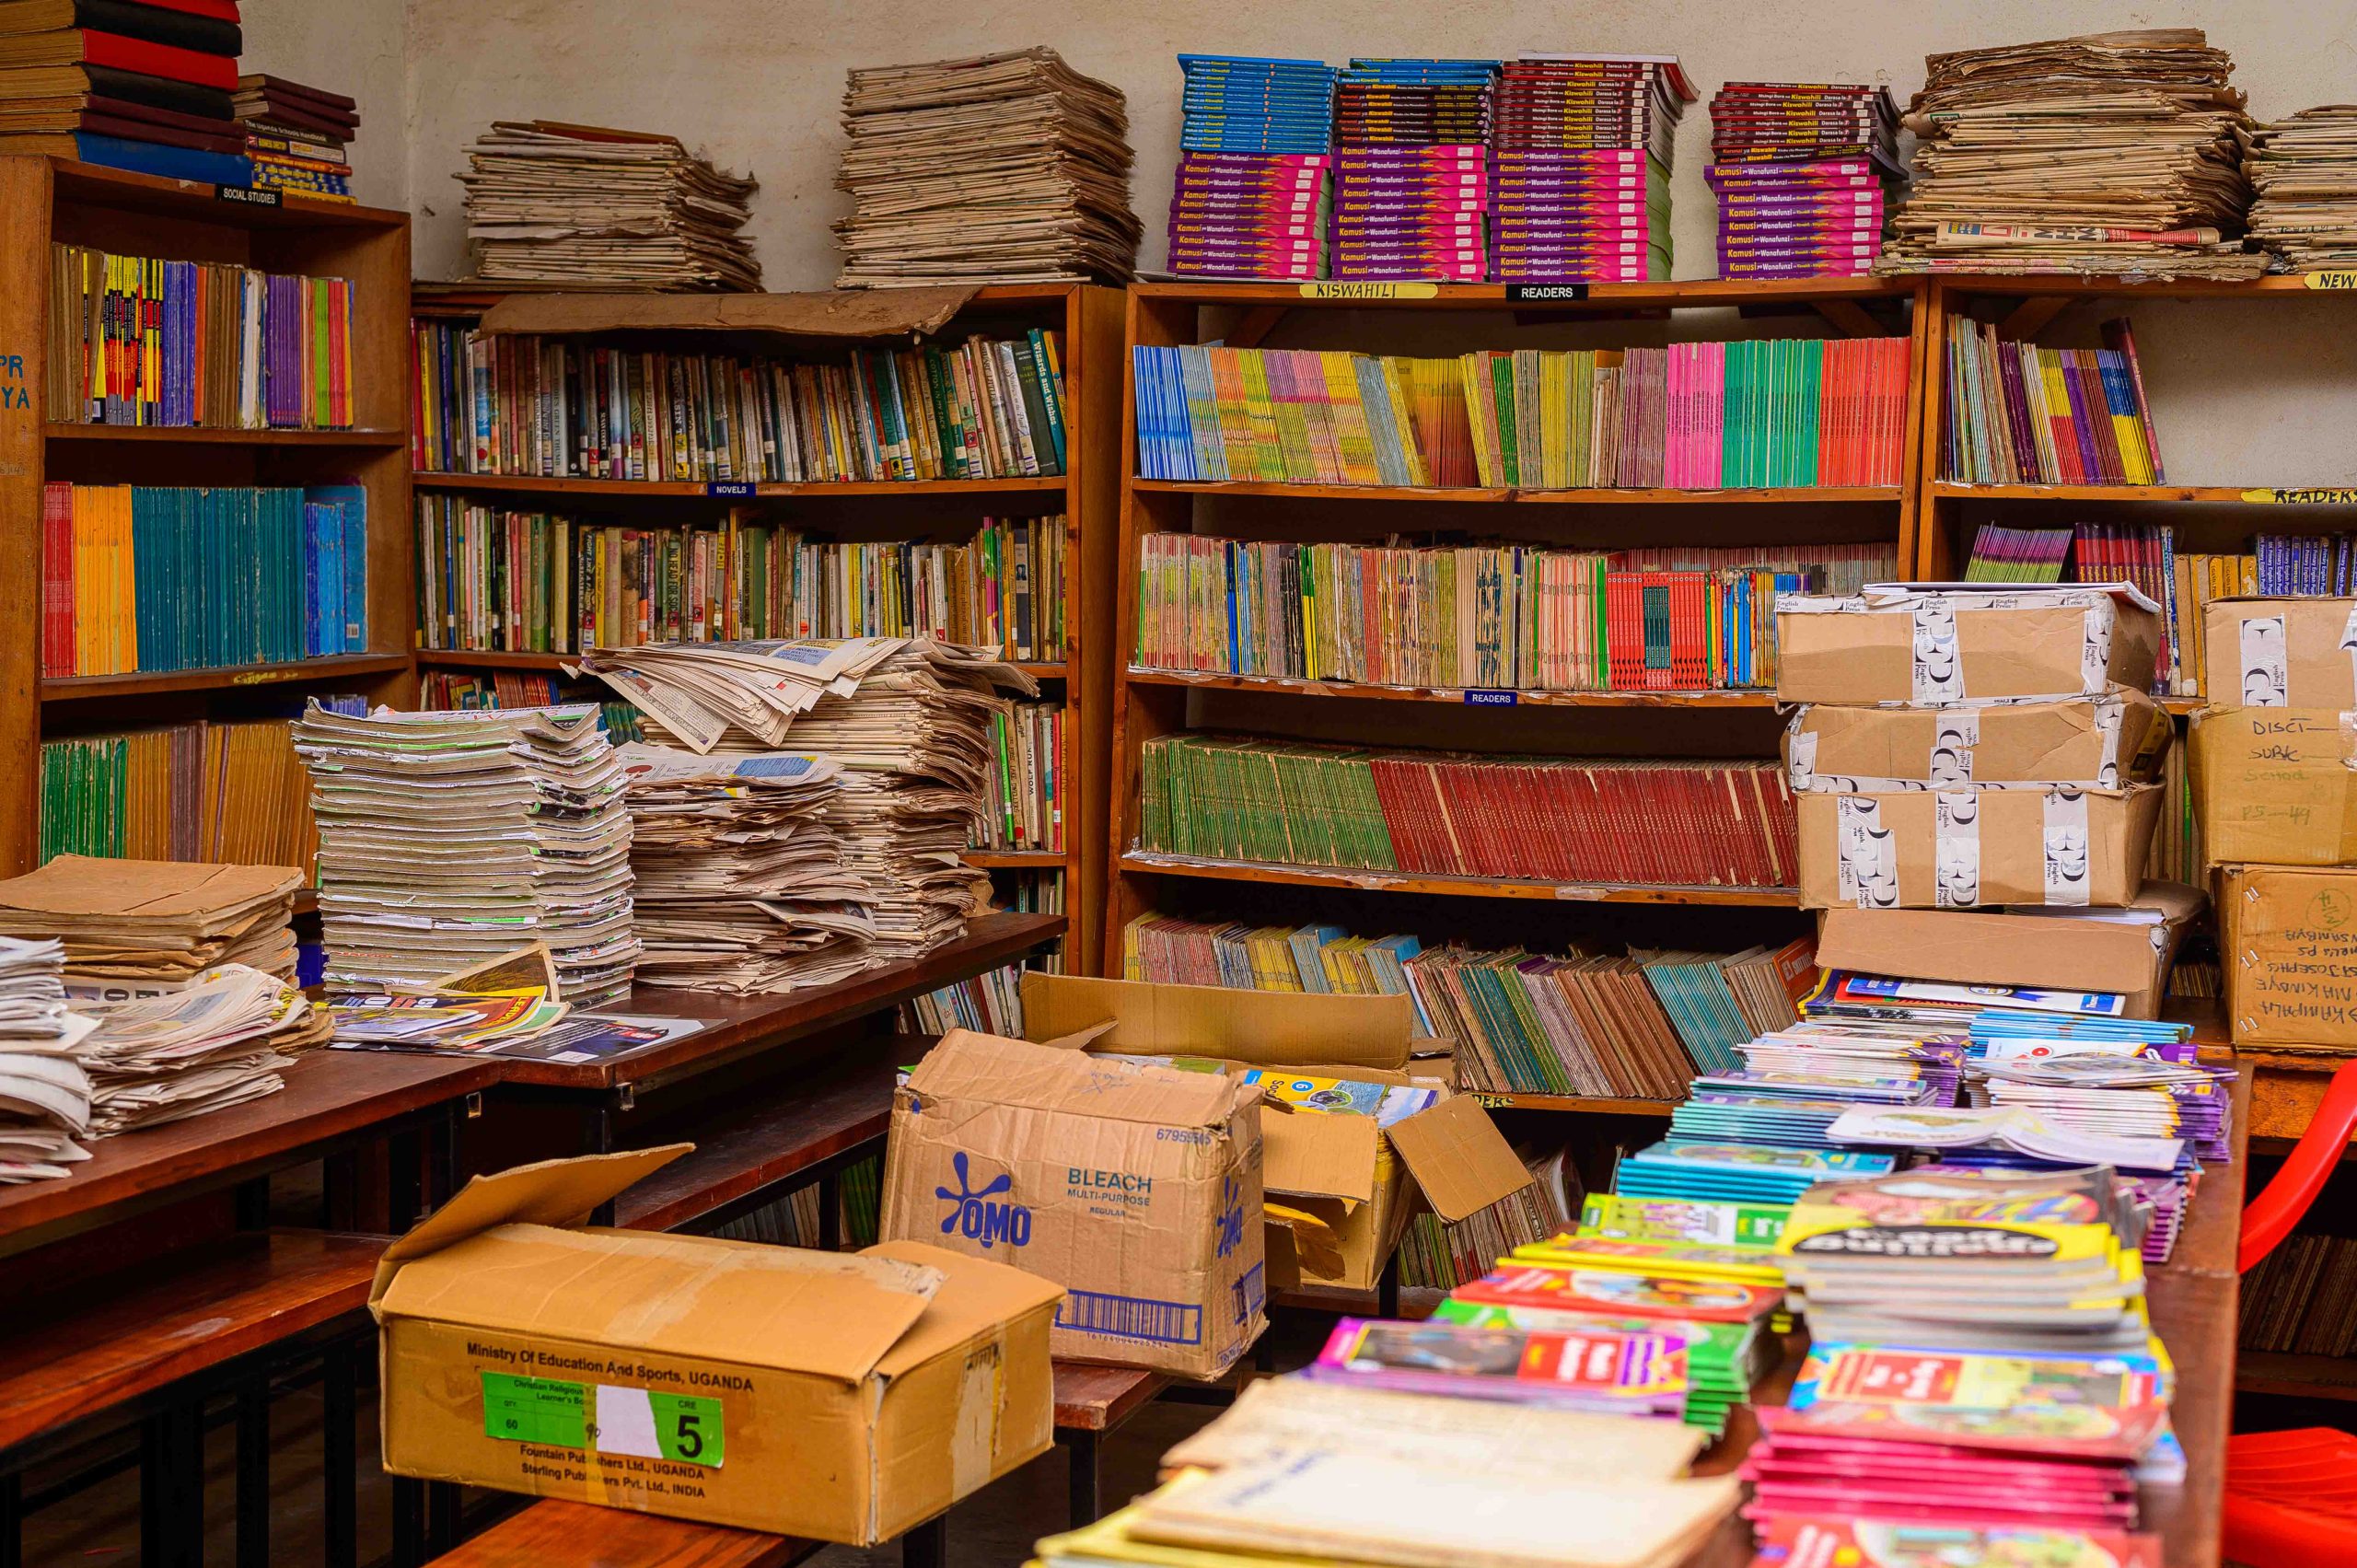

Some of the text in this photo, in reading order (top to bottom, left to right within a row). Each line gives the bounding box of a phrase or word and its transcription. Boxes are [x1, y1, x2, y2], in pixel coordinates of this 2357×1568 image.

[1341, 146, 1367, 156] Kamusi
[1497, 151, 1524, 160] Kamusi
[1191, 153, 1217, 161] Kamusi
[1185, 165, 1210, 173] Kamusi
[1714, 167, 1779, 177] Kamusi Wanafunzi
[1345, 175, 1371, 183] Kamusi
[1499, 178, 1526, 186] Kamusi
[223, 188, 276, 204] SOCIAL STUDIES
[1728, 193, 1792, 203] Kamusi Wanafunzi
[1339, 227, 1364, 237] Kamusi
[1501, 230, 1527, 239] Kamusi
[1726, 234, 1790, 244] Kamusi Wanafunzi
[1177, 261, 1202, 270] Kamusi
[1341, 266, 1402, 274] Kamusi Wanafunzi
[1729, 261, 1793, 272] Kamusi Wanafunzi
[1500, 268, 1562, 276] Kamusi Wanafunzi
[2319, 273, 2357, 288] NEW
[1316, 284, 1397, 298] KISWAHILI
[1521, 287, 1573, 298] READERS
[1033, 342, 1057, 425] Wizards and Wishes
[668, 548, 678, 558] NO
[668, 560, 678, 579] HEAD
[668, 581, 678, 597] FOR
[1472, 693, 1511, 703] READERS
[2261, 1001, 2345, 1025] KAMPALA
[1068, 1167, 1152, 1194] BLEACH
[1067, 1189, 1151, 1206] MULTI-PURPOSE
[1089, 1206, 1126, 1217] REGULAR
[961, 1199, 1032, 1248] OMO
[467, 1342, 754, 1392] Ministry Of Education And Sports, UGANDA
[514, 1379, 584, 1397] Christian Religious
[537, 1392, 572, 1404] Learner's
[504, 1400, 517, 1408] QTY
[678, 1400, 696, 1410] CRE
[505, 1419, 518, 1430] 60
[677, 1414, 703, 1458] 5
[520, 1445, 704, 1480] Fountain Ltd., UGANDA
[521, 1463, 705, 1498] Sterling Pvt. Ltd., INDIA
